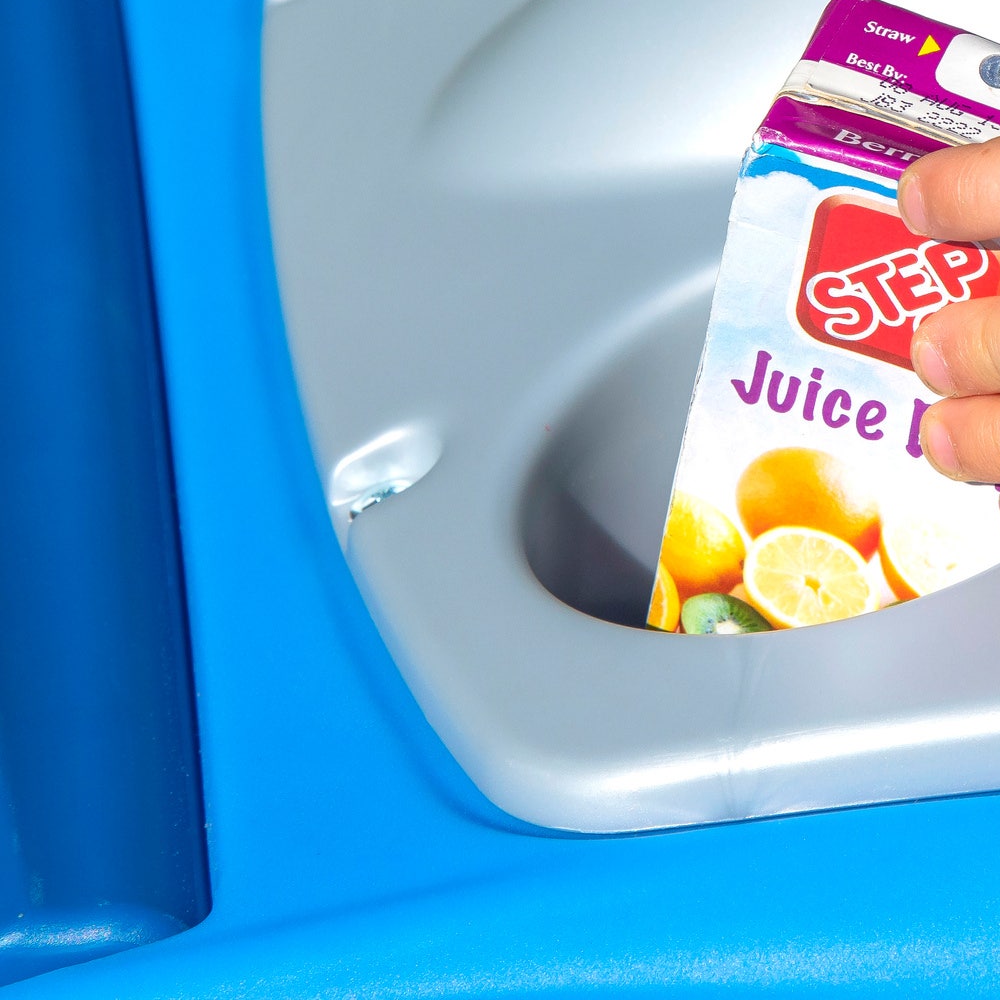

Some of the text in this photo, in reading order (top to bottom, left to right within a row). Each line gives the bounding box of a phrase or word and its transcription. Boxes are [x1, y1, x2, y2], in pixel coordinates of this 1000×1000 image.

[863, 21, 916, 44] Straw
[846, 53, 908, 84] Best By:
[920, 94, 972, 116] AUG
[833, 128, 921, 161] Berr
[806, 239, 989, 341] STEP
[730, 350, 887, 441] Juice
